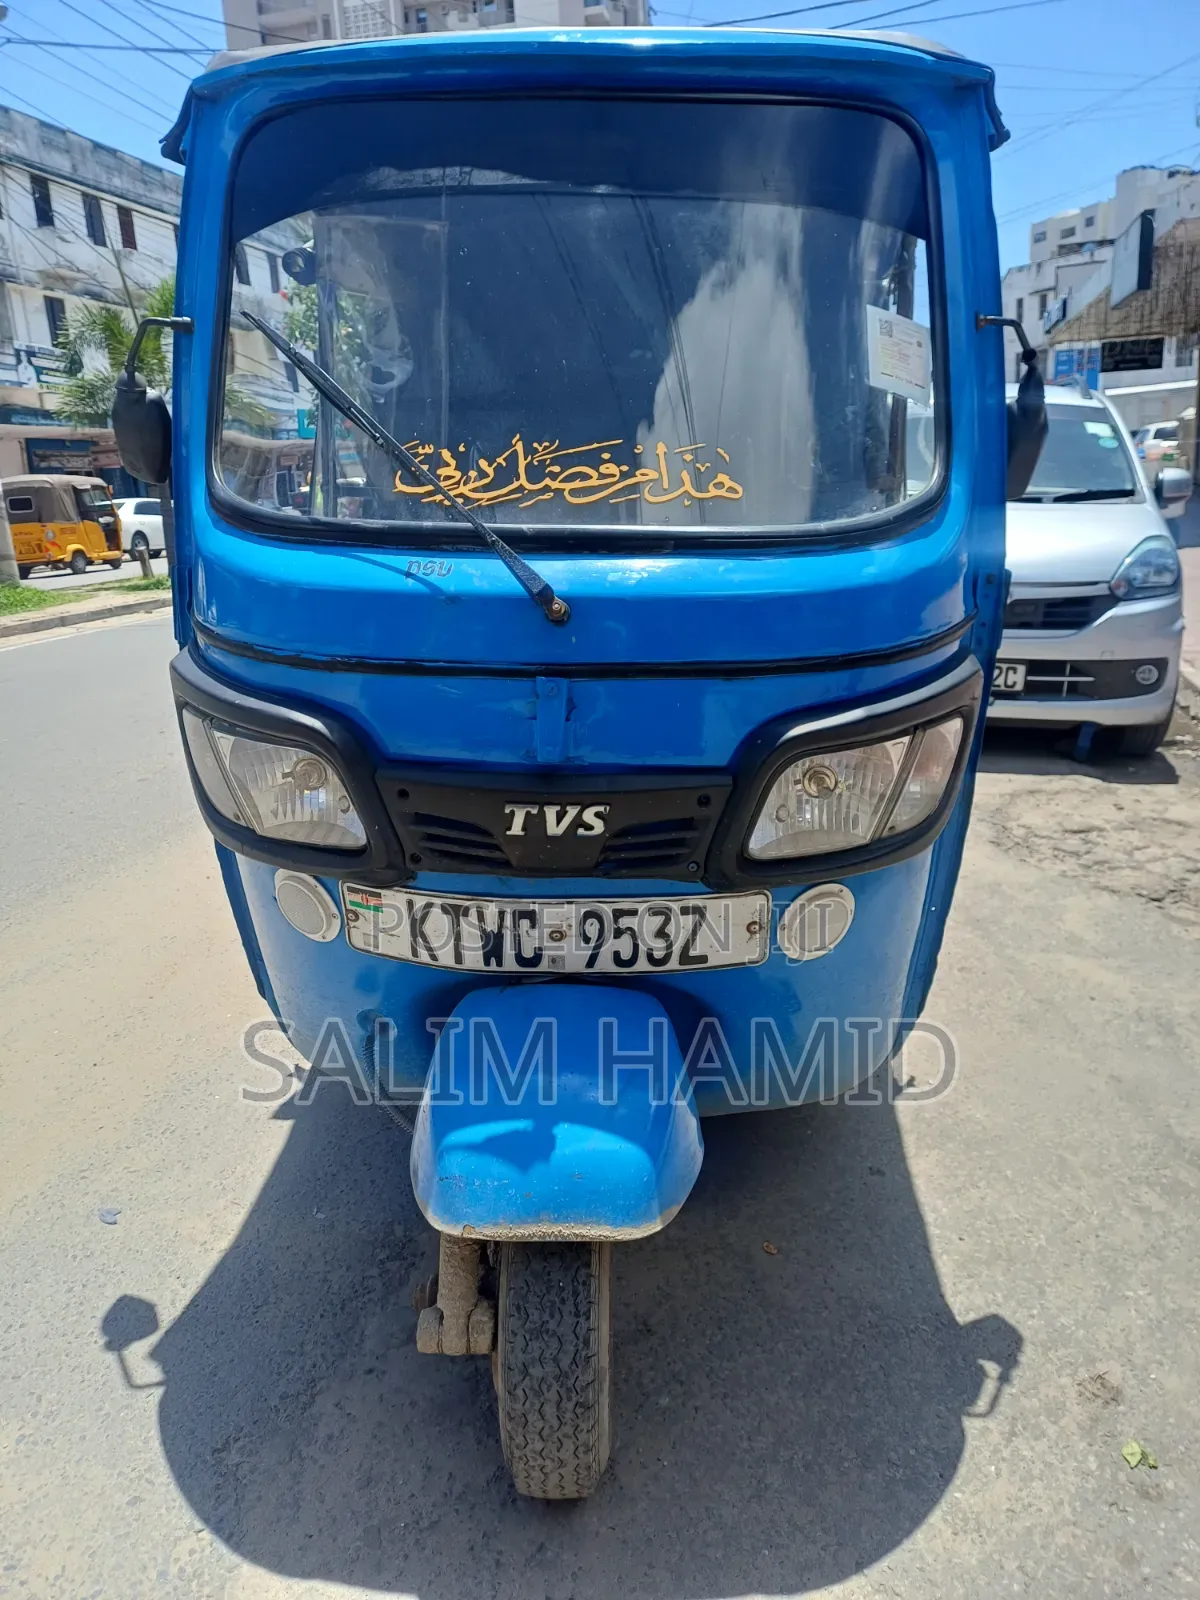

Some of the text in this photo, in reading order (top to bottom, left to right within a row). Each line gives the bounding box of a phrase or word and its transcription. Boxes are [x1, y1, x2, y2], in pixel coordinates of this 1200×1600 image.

[504, 804, 610, 837] TVS
[406, 898, 709, 969] KTWC 953Z
